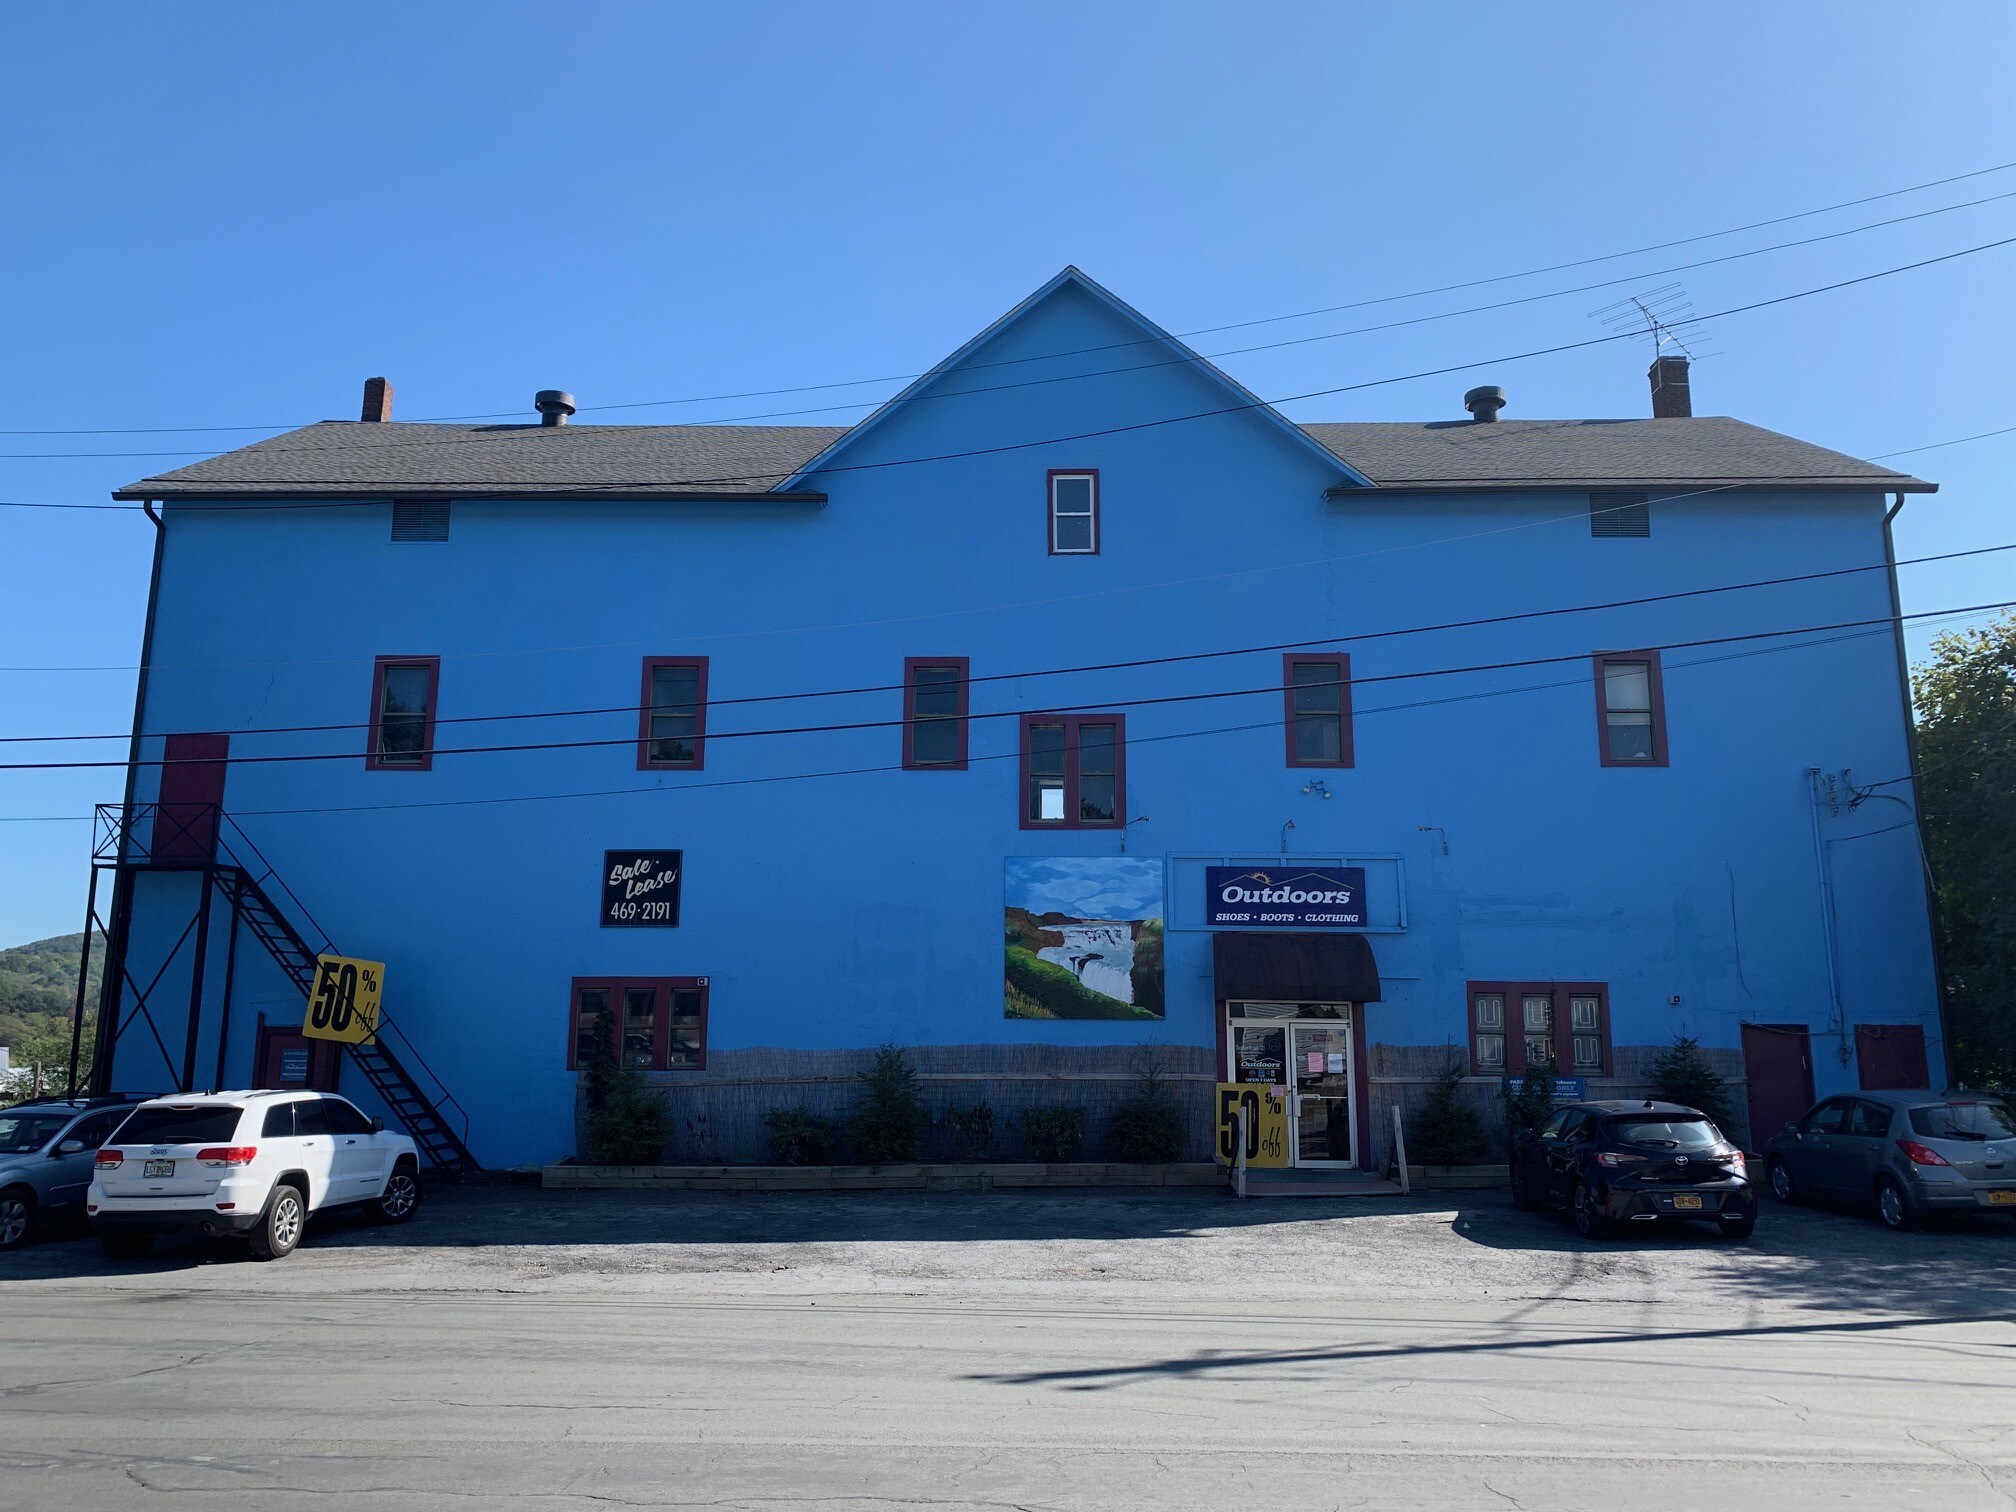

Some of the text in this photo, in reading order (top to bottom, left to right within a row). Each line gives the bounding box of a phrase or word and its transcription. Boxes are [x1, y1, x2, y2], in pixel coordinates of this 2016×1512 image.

[609, 858, 654, 886] Sale
[625, 868, 678, 899] Lease
[1222, 886, 1351, 904] Outdoors
[1215, 913, 1359, 922] SHOES BOOTS CLOTHING
[1262, 1126, 1281, 1158] off
